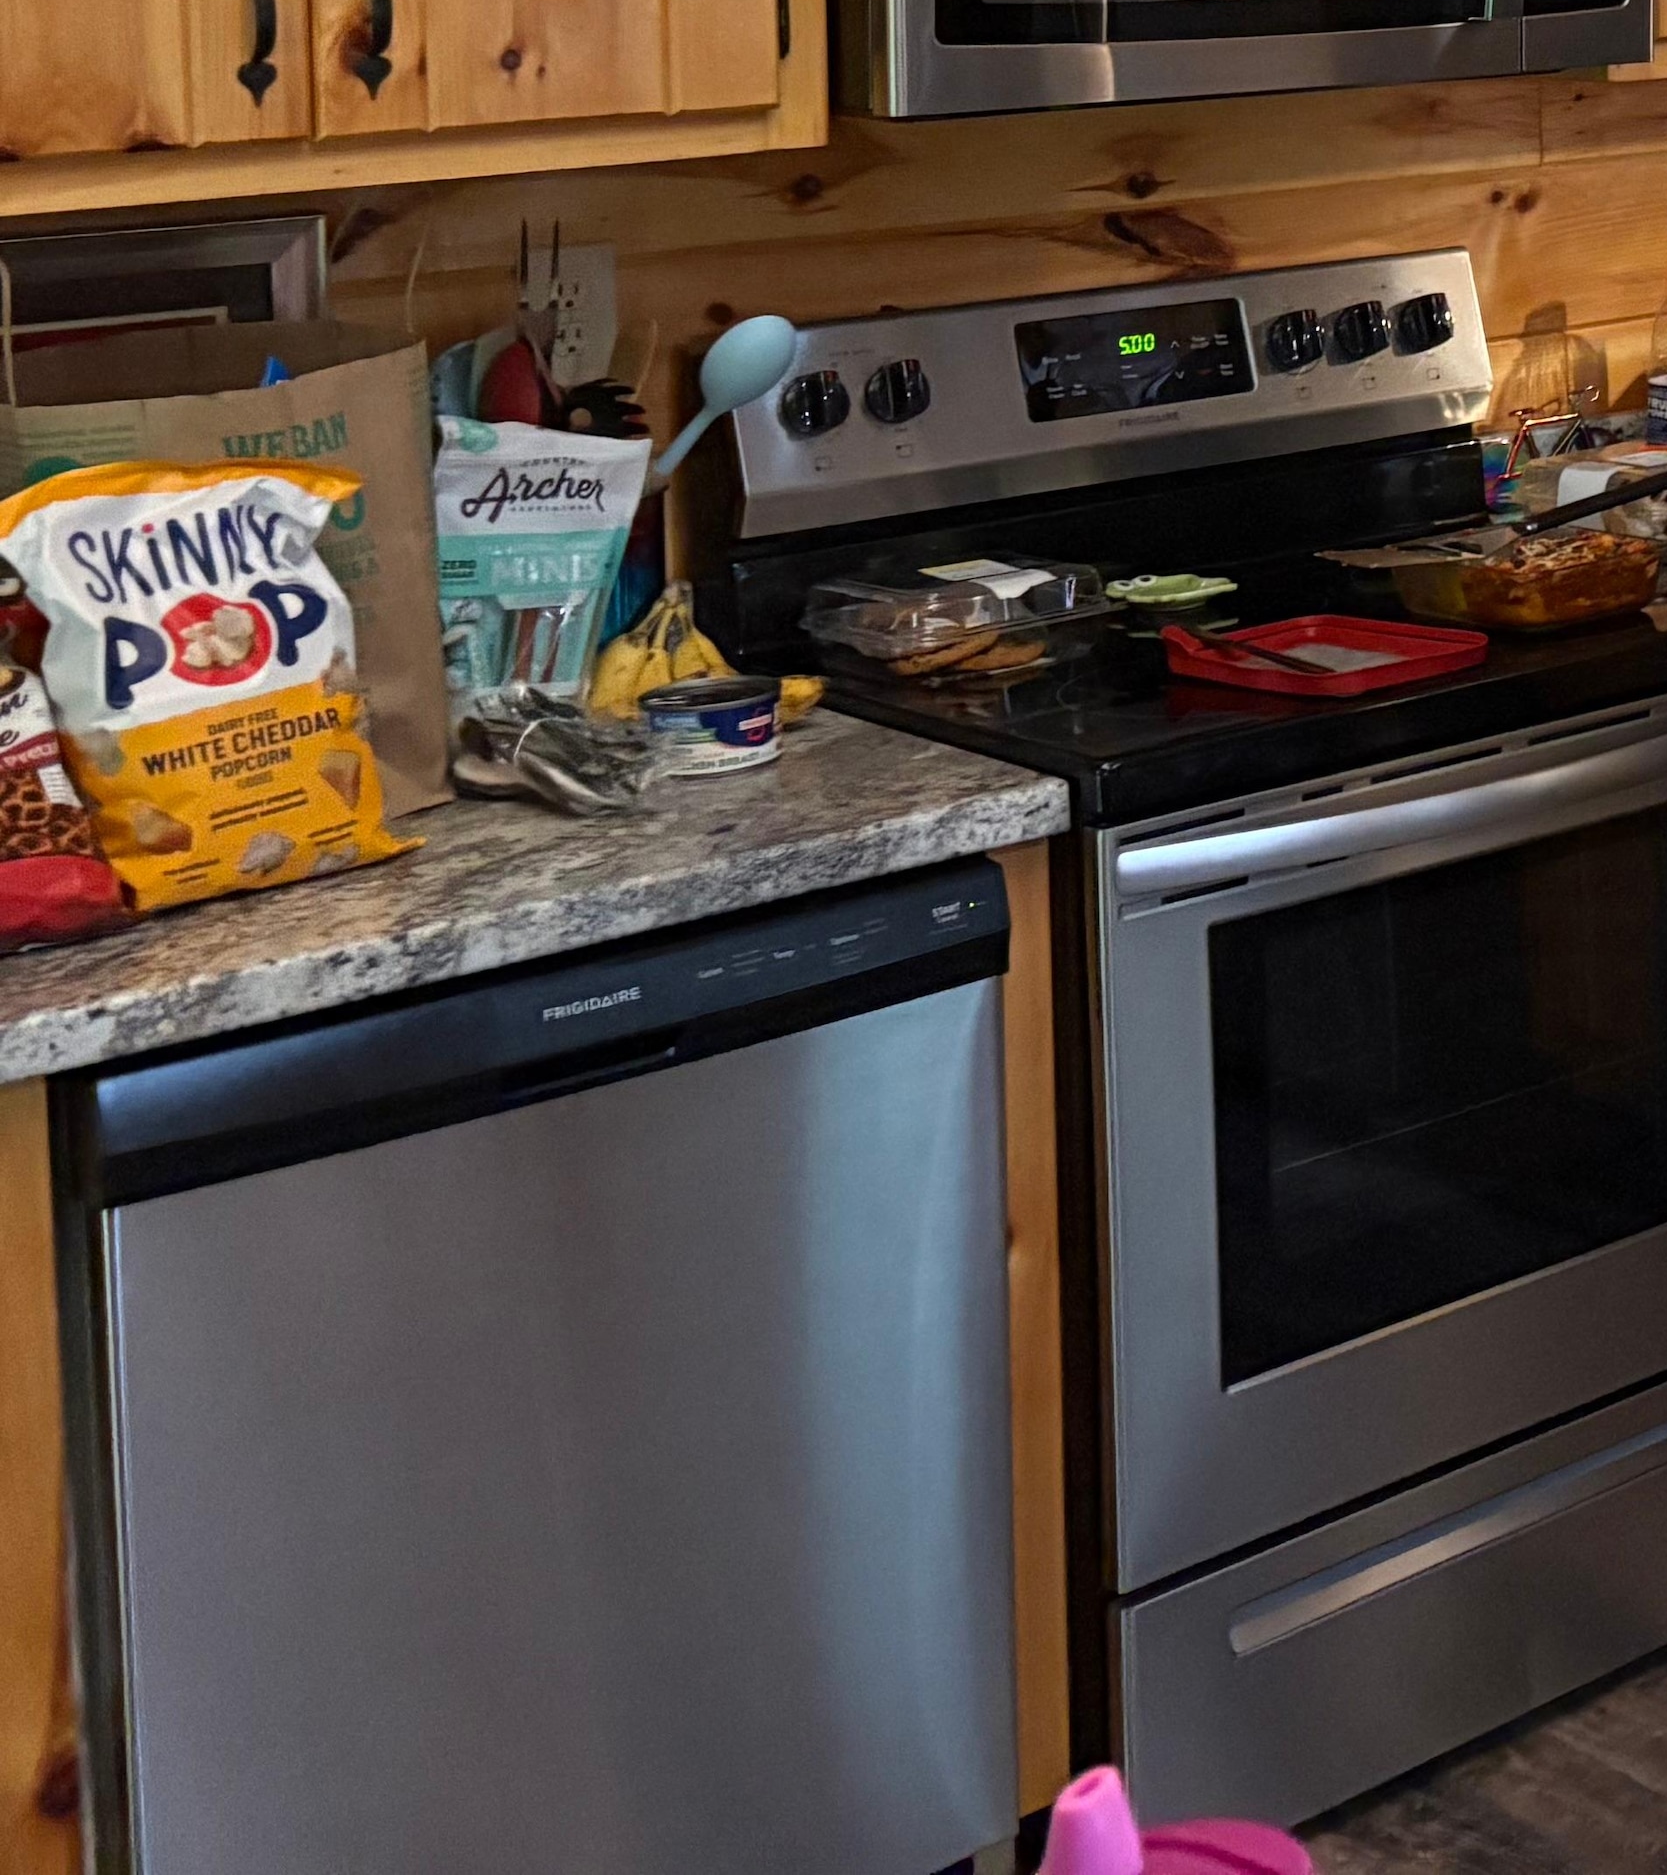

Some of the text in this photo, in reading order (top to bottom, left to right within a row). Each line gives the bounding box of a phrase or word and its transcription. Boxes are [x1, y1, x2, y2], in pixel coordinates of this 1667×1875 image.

[461, 467, 605, 524] Archer
[104, 580, 327, 709] POP
[143, 707, 342, 776] WHITE CHEDDAR
[211, 746, 293, 782] POPCORN
[543, 986, 642, 1022] FRIGIDAIRE
